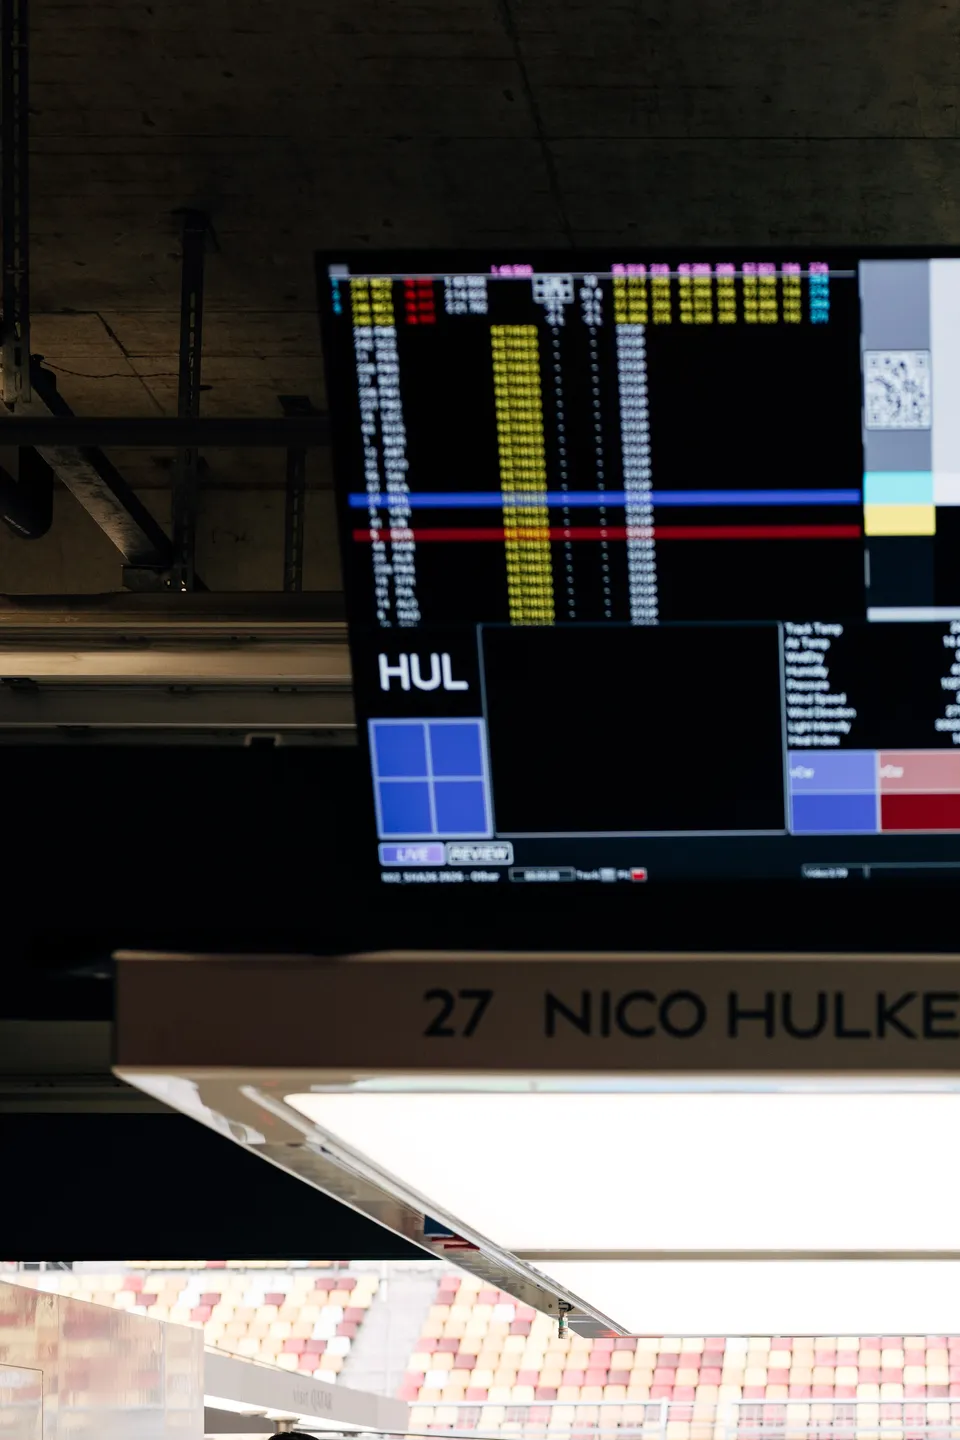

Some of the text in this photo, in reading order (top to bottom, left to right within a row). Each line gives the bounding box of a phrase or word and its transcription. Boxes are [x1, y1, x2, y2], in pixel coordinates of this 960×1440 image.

[378, 652, 469, 691] HUL
[422, 988, 494, 1038] 27
[544, 989, 707, 1039] NICO
